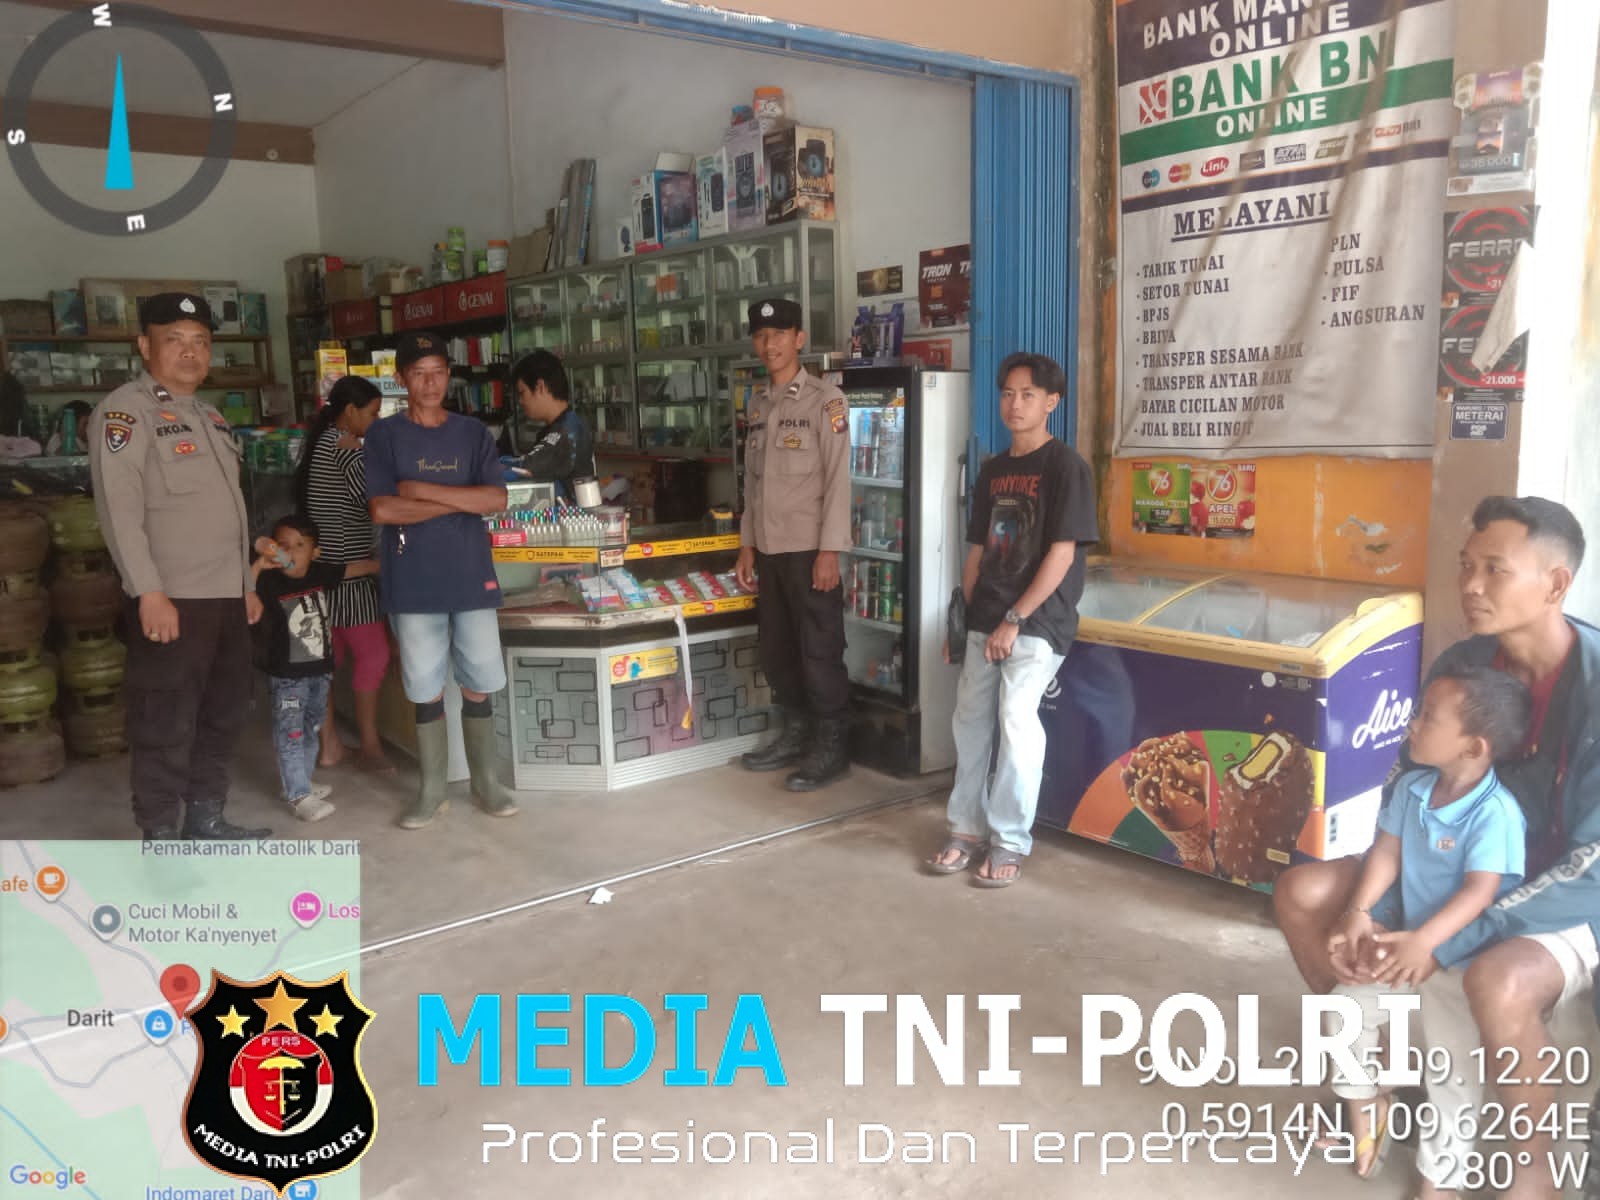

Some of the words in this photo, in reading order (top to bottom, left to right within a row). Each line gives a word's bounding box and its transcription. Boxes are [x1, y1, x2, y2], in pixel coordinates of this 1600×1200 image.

[1143, 2, 1221, 49] BANK
[1210, 2, 1350, 58] ONLINE
[1172, 54, 1300, 118] BANK
[1216, 96, 1327, 138] ONLINE
[1174, 191, 1330, 235] MELAYANI
[1331, 233, 1361, 252] PLN
[1143, 261, 1177, 278] TARIK
[1180, 255, 1225, 274] TUNAI
[1333, 255, 1385, 277] PULSA
[1142, 282, 1181, 301] SETOR
[1183, 277, 1230, 298] TUNAI
[1331, 285, 1360, 302] FIF
[1143, 307, 1170, 323] BPJS
[1330, 304, 1426, 328] ANGSURAN
[1143, 329, 1176, 345] BRIVA
[1142, 350, 1206, 369] TRANSPER
[1210, 347, 1270, 366] SESAMA
[1142, 374, 1206, 392] TRANSPER
[1209, 372, 1258, 390] ANTAR
[1141, 398, 1176, 414] BAYAR
[1179, 397, 1238, 414] CICILAN
[1241, 395, 1285, 411] MOTOR
[1455, 411, 1504, 421] METERAI
[1140, 422, 1169, 438] JUAL
[1172, 422, 1202, 437] BELI
[1352, 688, 1413, 749] Aice
